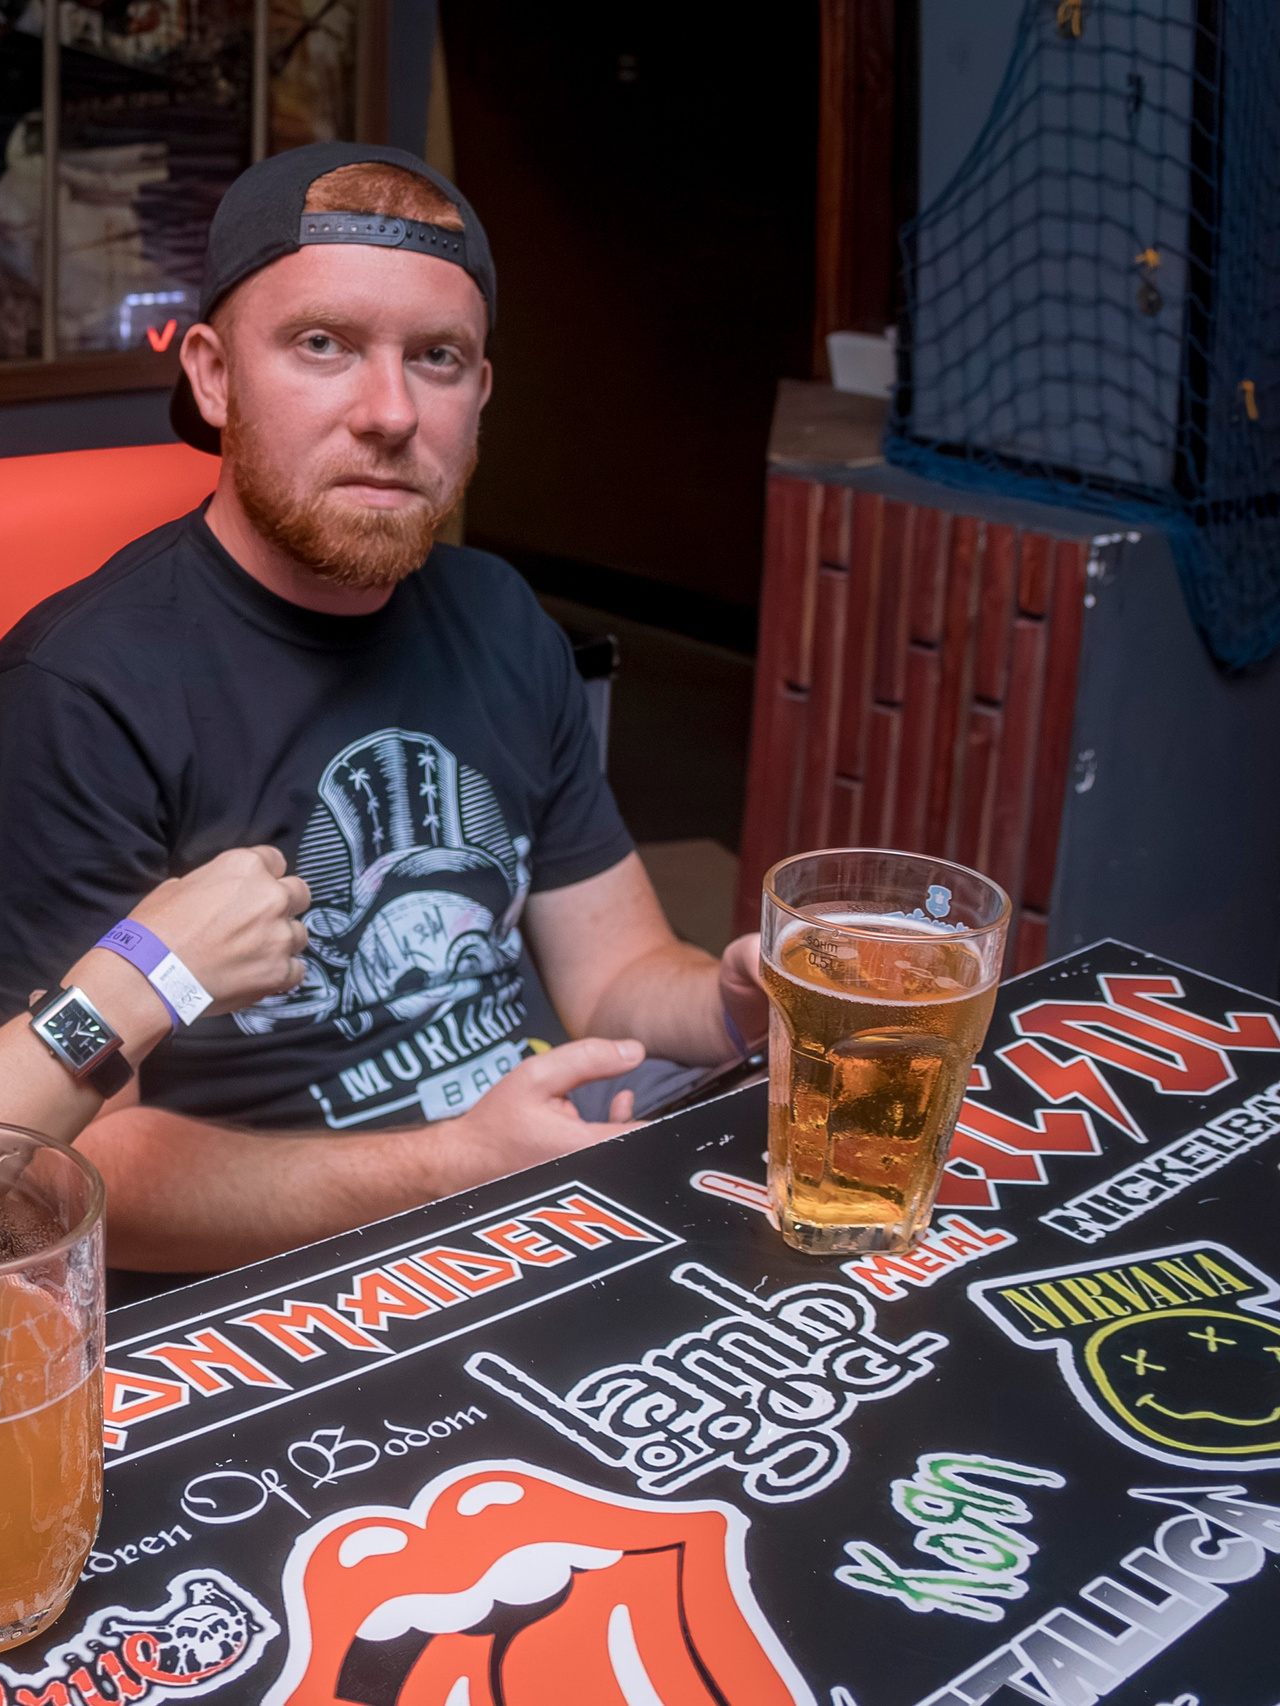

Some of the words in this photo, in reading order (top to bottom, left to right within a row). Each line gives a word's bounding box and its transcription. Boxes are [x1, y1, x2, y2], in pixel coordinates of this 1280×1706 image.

[224, 1193, 665, 1357] MAIDEN
[843, 1215, 1015, 1300] METAL
[997, 1253, 1254, 1333] NIRVANA
[180, 1468, 312, 1525] Of
[286, 1405, 489, 1489] Bodom
[913, 1484, 1280, 1706] TALLICA
